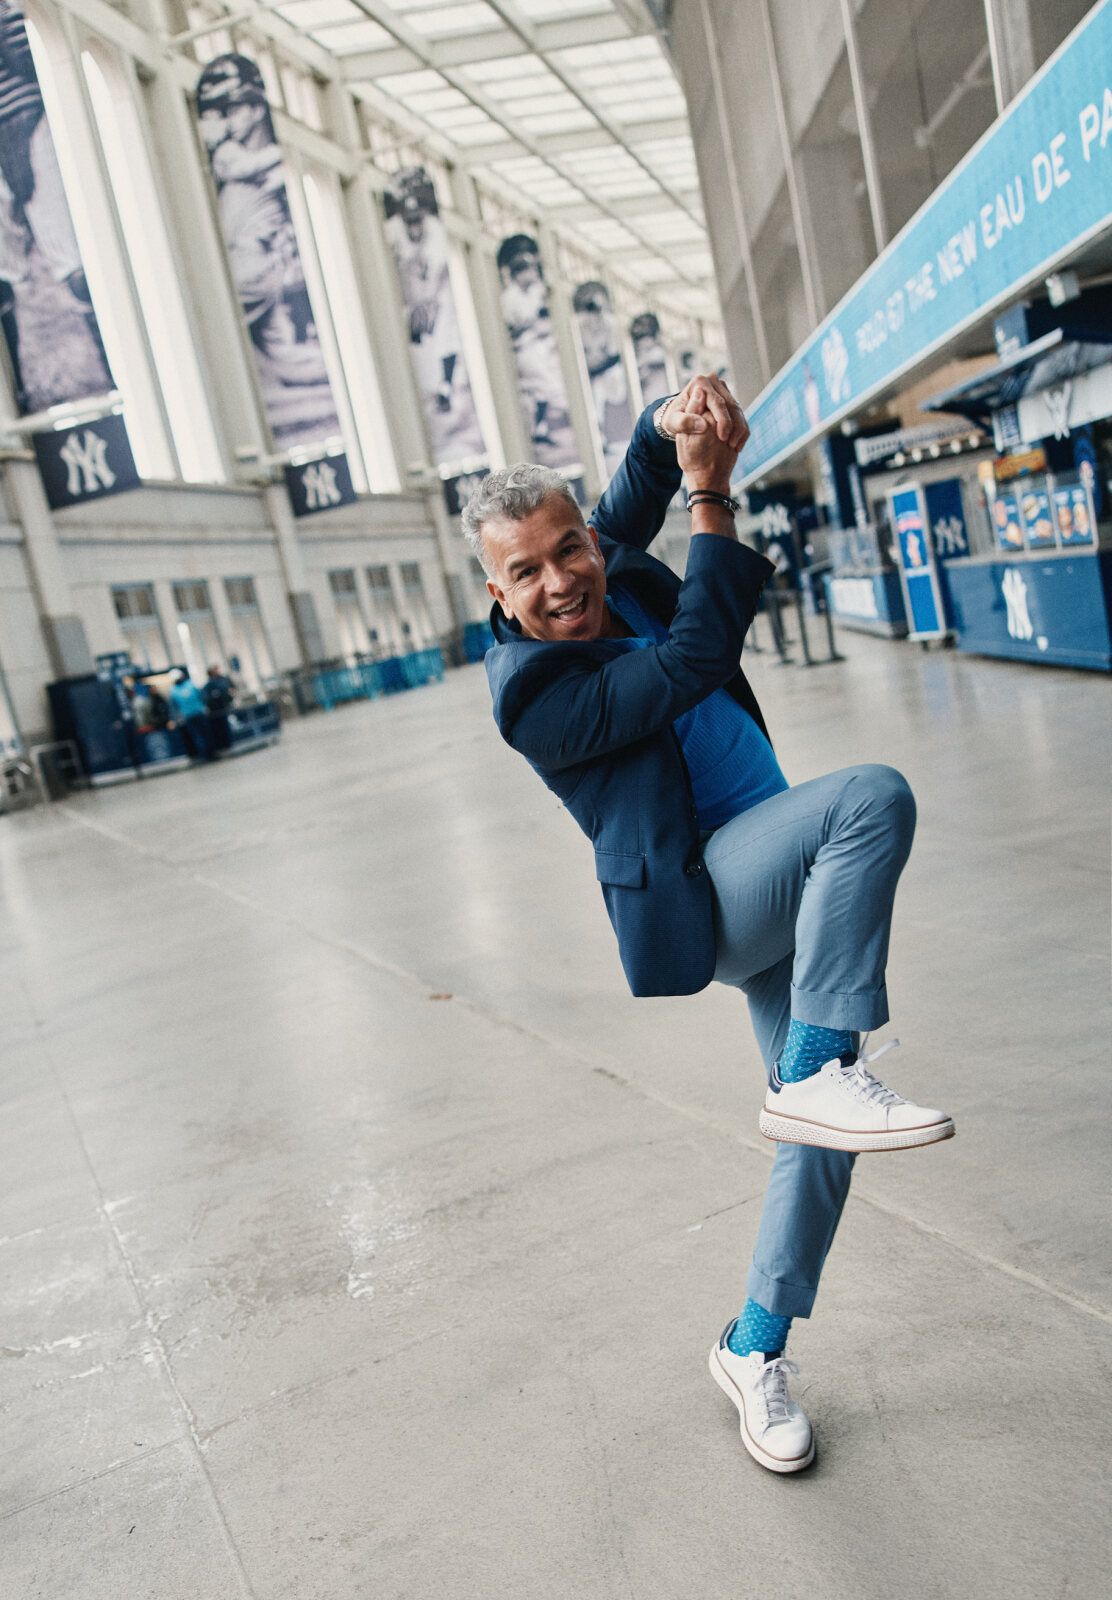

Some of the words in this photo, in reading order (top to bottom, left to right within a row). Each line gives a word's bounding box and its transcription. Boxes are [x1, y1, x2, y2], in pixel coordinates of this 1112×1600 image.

[937, 219, 977, 286] NEW
[980, 175, 1025, 249] EAU
[1032, 132, 1071, 204] DE
[60, 429, 116, 496] NY
[302, 461, 341, 509] NY
